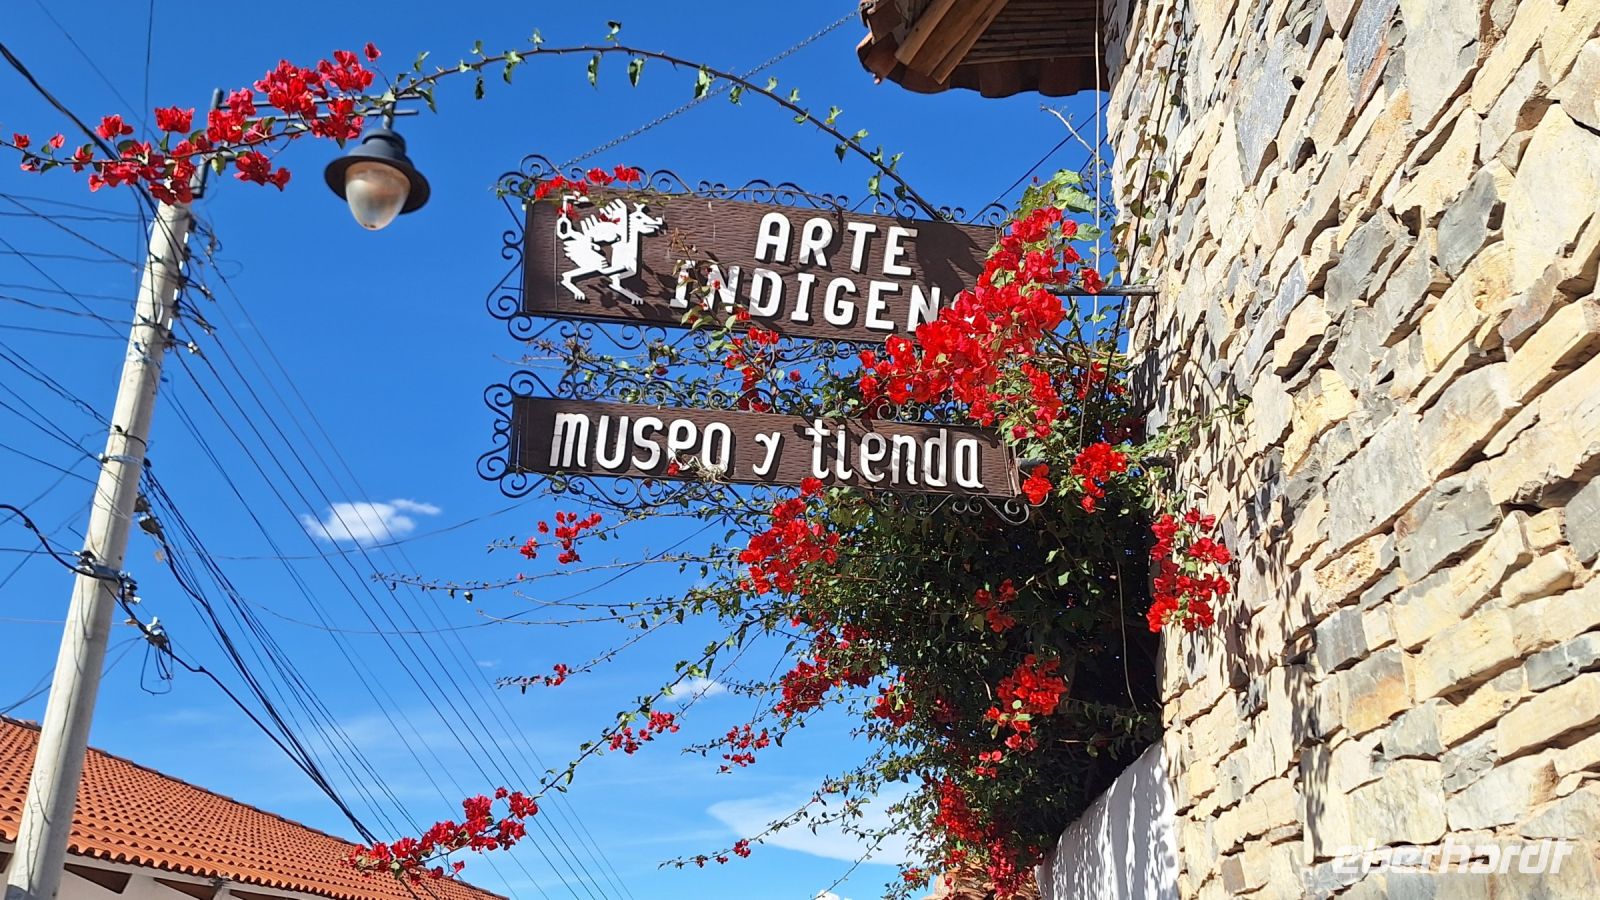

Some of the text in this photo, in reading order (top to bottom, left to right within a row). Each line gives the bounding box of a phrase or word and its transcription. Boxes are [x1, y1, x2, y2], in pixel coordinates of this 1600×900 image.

[754, 212, 919, 276] ARTE
[669, 259, 976, 337] INDIGEN
[752, 431, 781, 476] y
[805, 417, 984, 489] tienda
